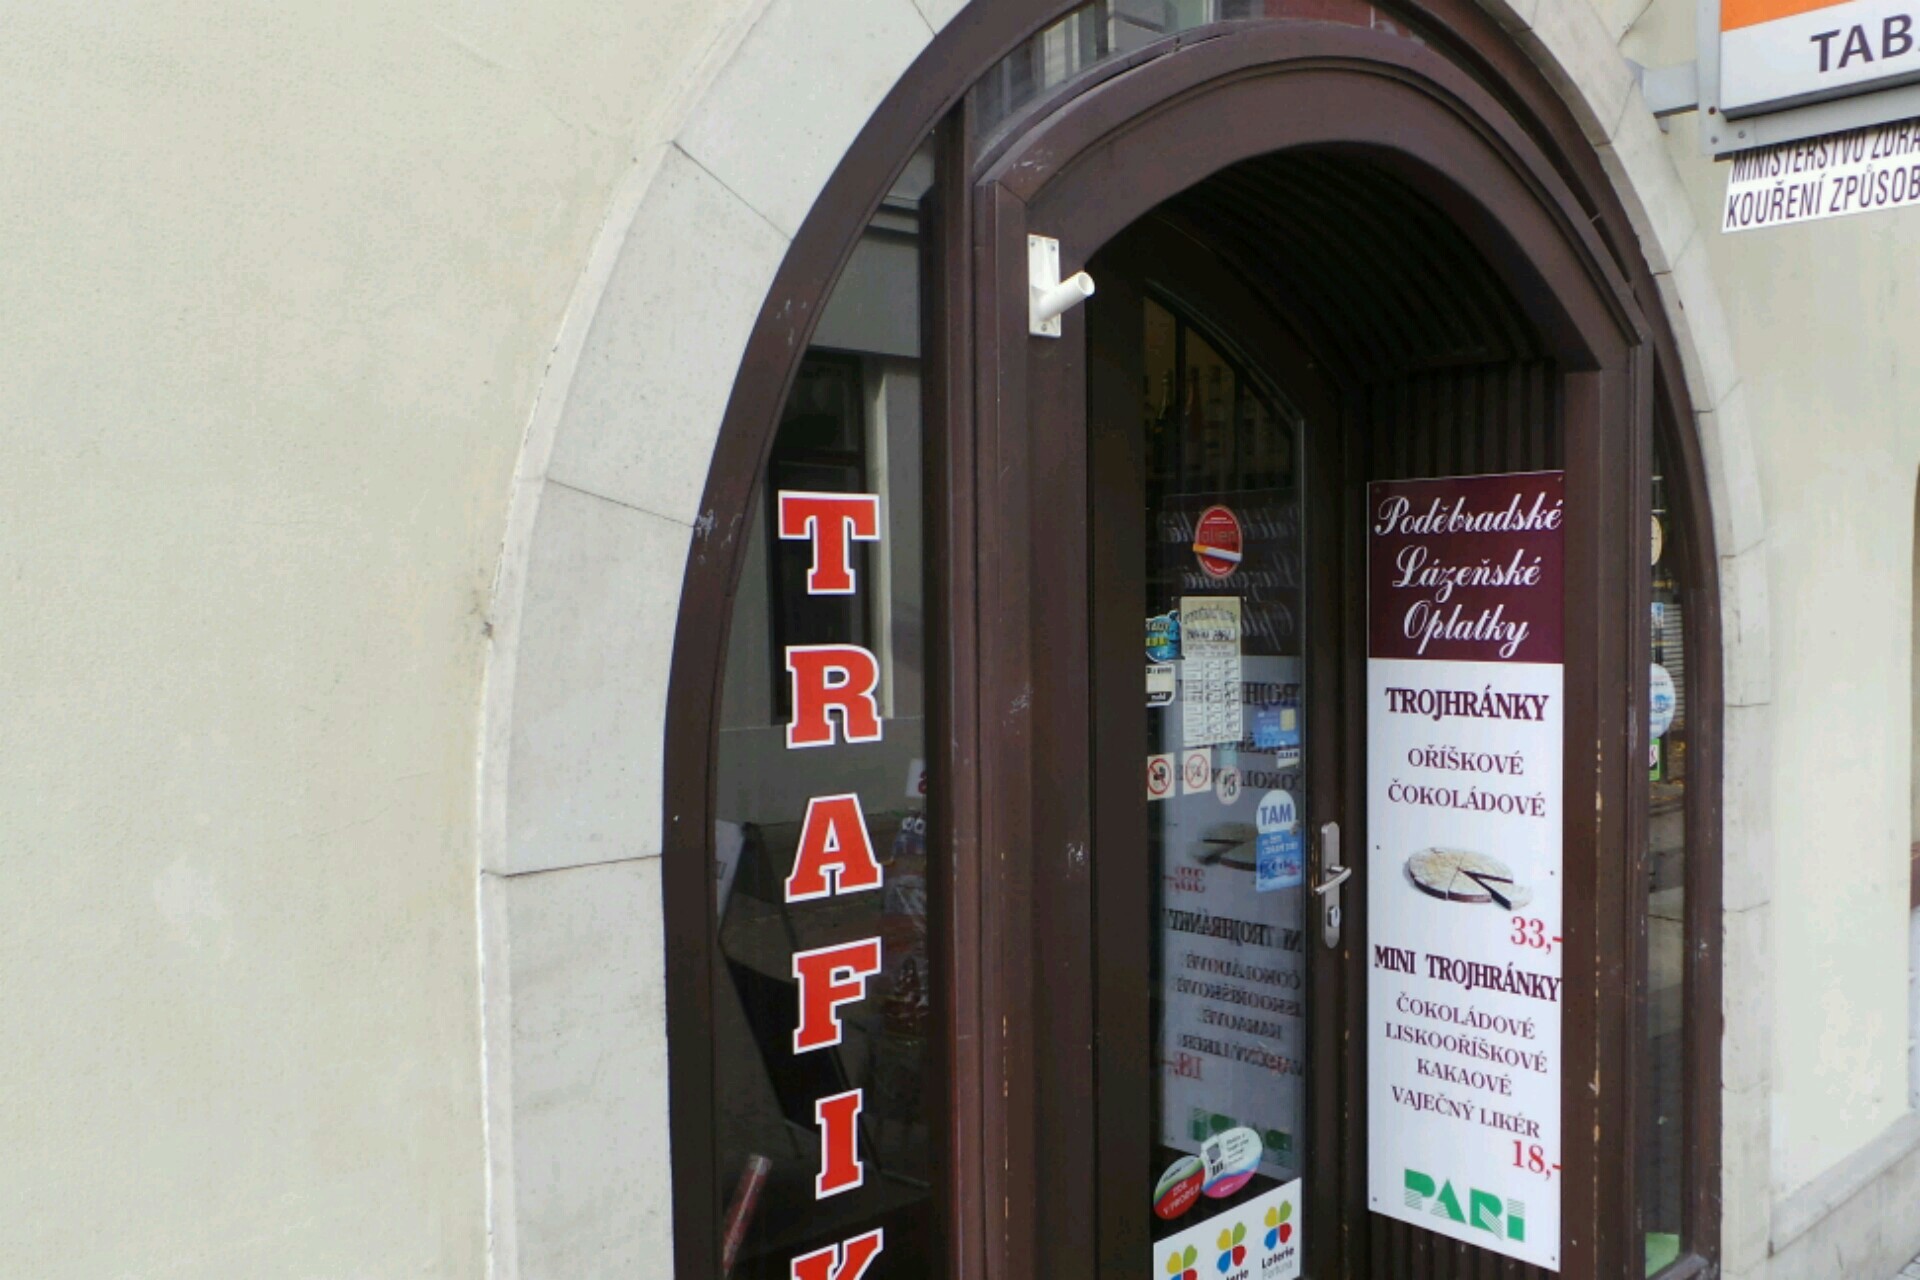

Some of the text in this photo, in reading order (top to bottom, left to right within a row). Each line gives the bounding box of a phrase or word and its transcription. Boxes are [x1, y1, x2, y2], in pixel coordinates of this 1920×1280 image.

[1810, 14, 1920, 73] TAB
[1726, 174, 1826, 229] KOUŘENÍ
[1374, 491, 1563, 536] Poděbradské
[1392, 545, 1542, 603] Lázeňské
[1403, 600, 1530, 658] Oplatky
[1385, 684, 1549, 721] TROJHRÁNKY
[1407, 744, 1524, 775] OŘÍŠKOVÉ
[1260, 803, 1292, 825] TAM
[1388, 778, 1545, 817] ČOKOLÁDOVÉ
[1510, 916, 1564, 954] 33,-
[1374, 944, 1562, 1002] MINI TROJHRÁNKY
[1396, 991, 1536, 1040] ČOKOLÁDOVÉ
[1385, 1022, 1548, 1074] LISKOOŘÍŠKOVÉ
[1416, 1057, 1512, 1097] KAKAOVÉ
[1390, 1085, 1540, 1139] VAJEČNÝ LIKÉR
[1511, 1140, 1562, 1181] 18,-
[1404, 1167, 1526, 1243] PARI
